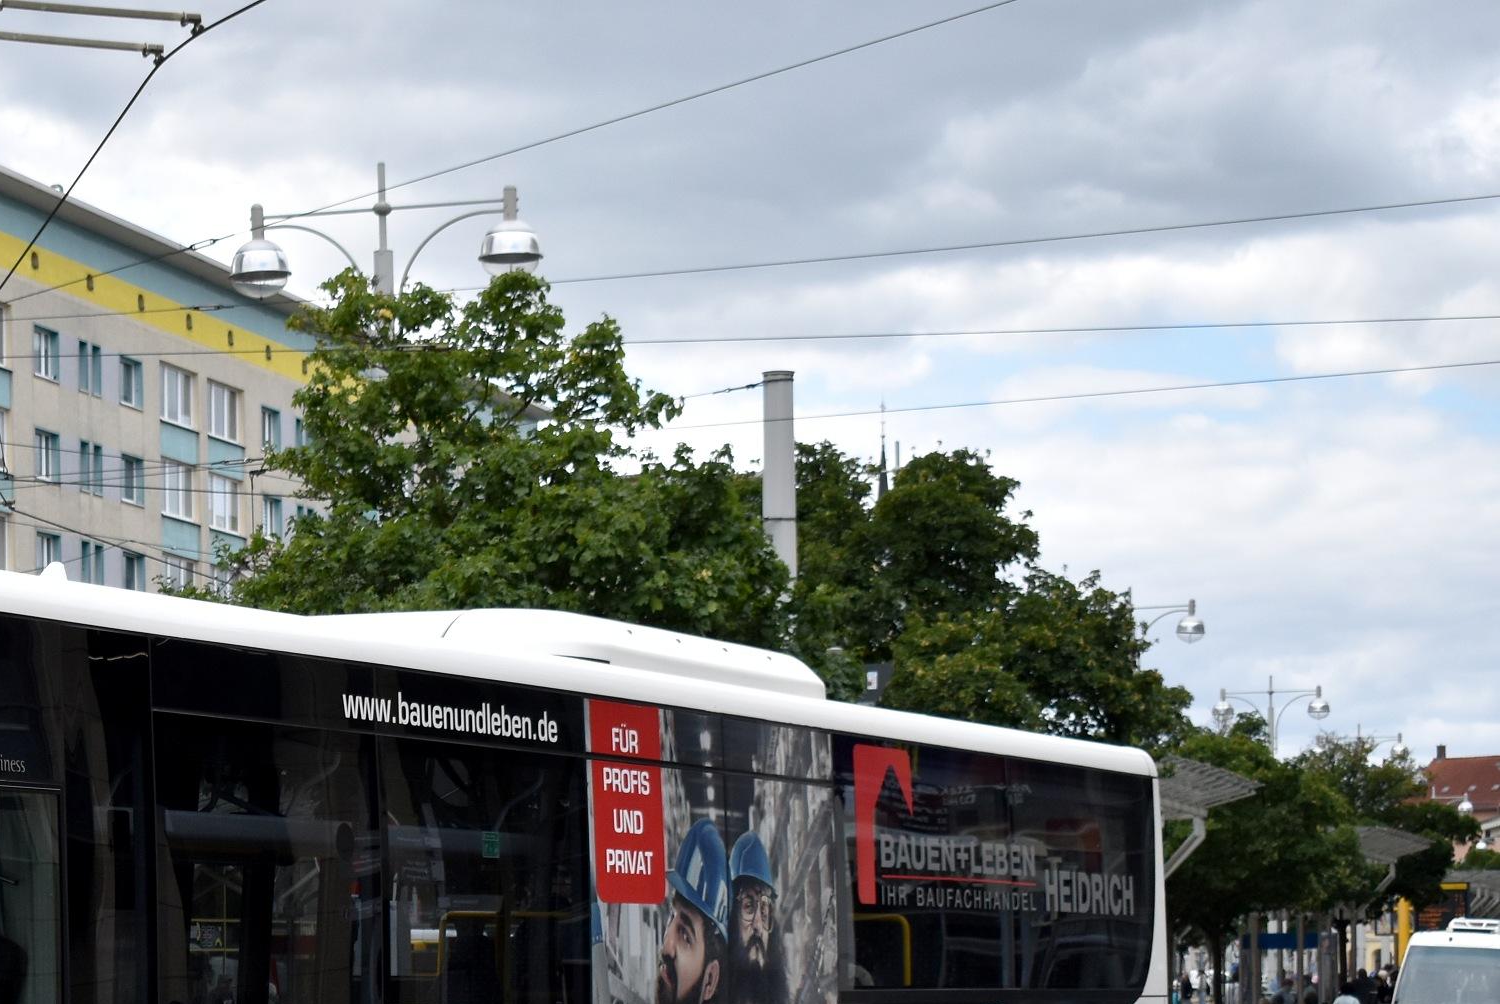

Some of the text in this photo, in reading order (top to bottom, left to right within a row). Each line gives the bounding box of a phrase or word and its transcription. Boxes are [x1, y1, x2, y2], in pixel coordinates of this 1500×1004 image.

[342, 692, 558, 743] www.bauenundleben.de
[611, 723, 640, 755] FÜR
[603, 767, 650, 796] PROFIS
[613, 810, 644, 835] UND
[606, 849, 653, 875] PRIVAT
[879, 833, 1036, 877] BAUEN+LEBEN
[880, 886, 1037, 912] IHR BAUFACHHANDEL
[1044, 868, 1134, 916] HEIDRICH
